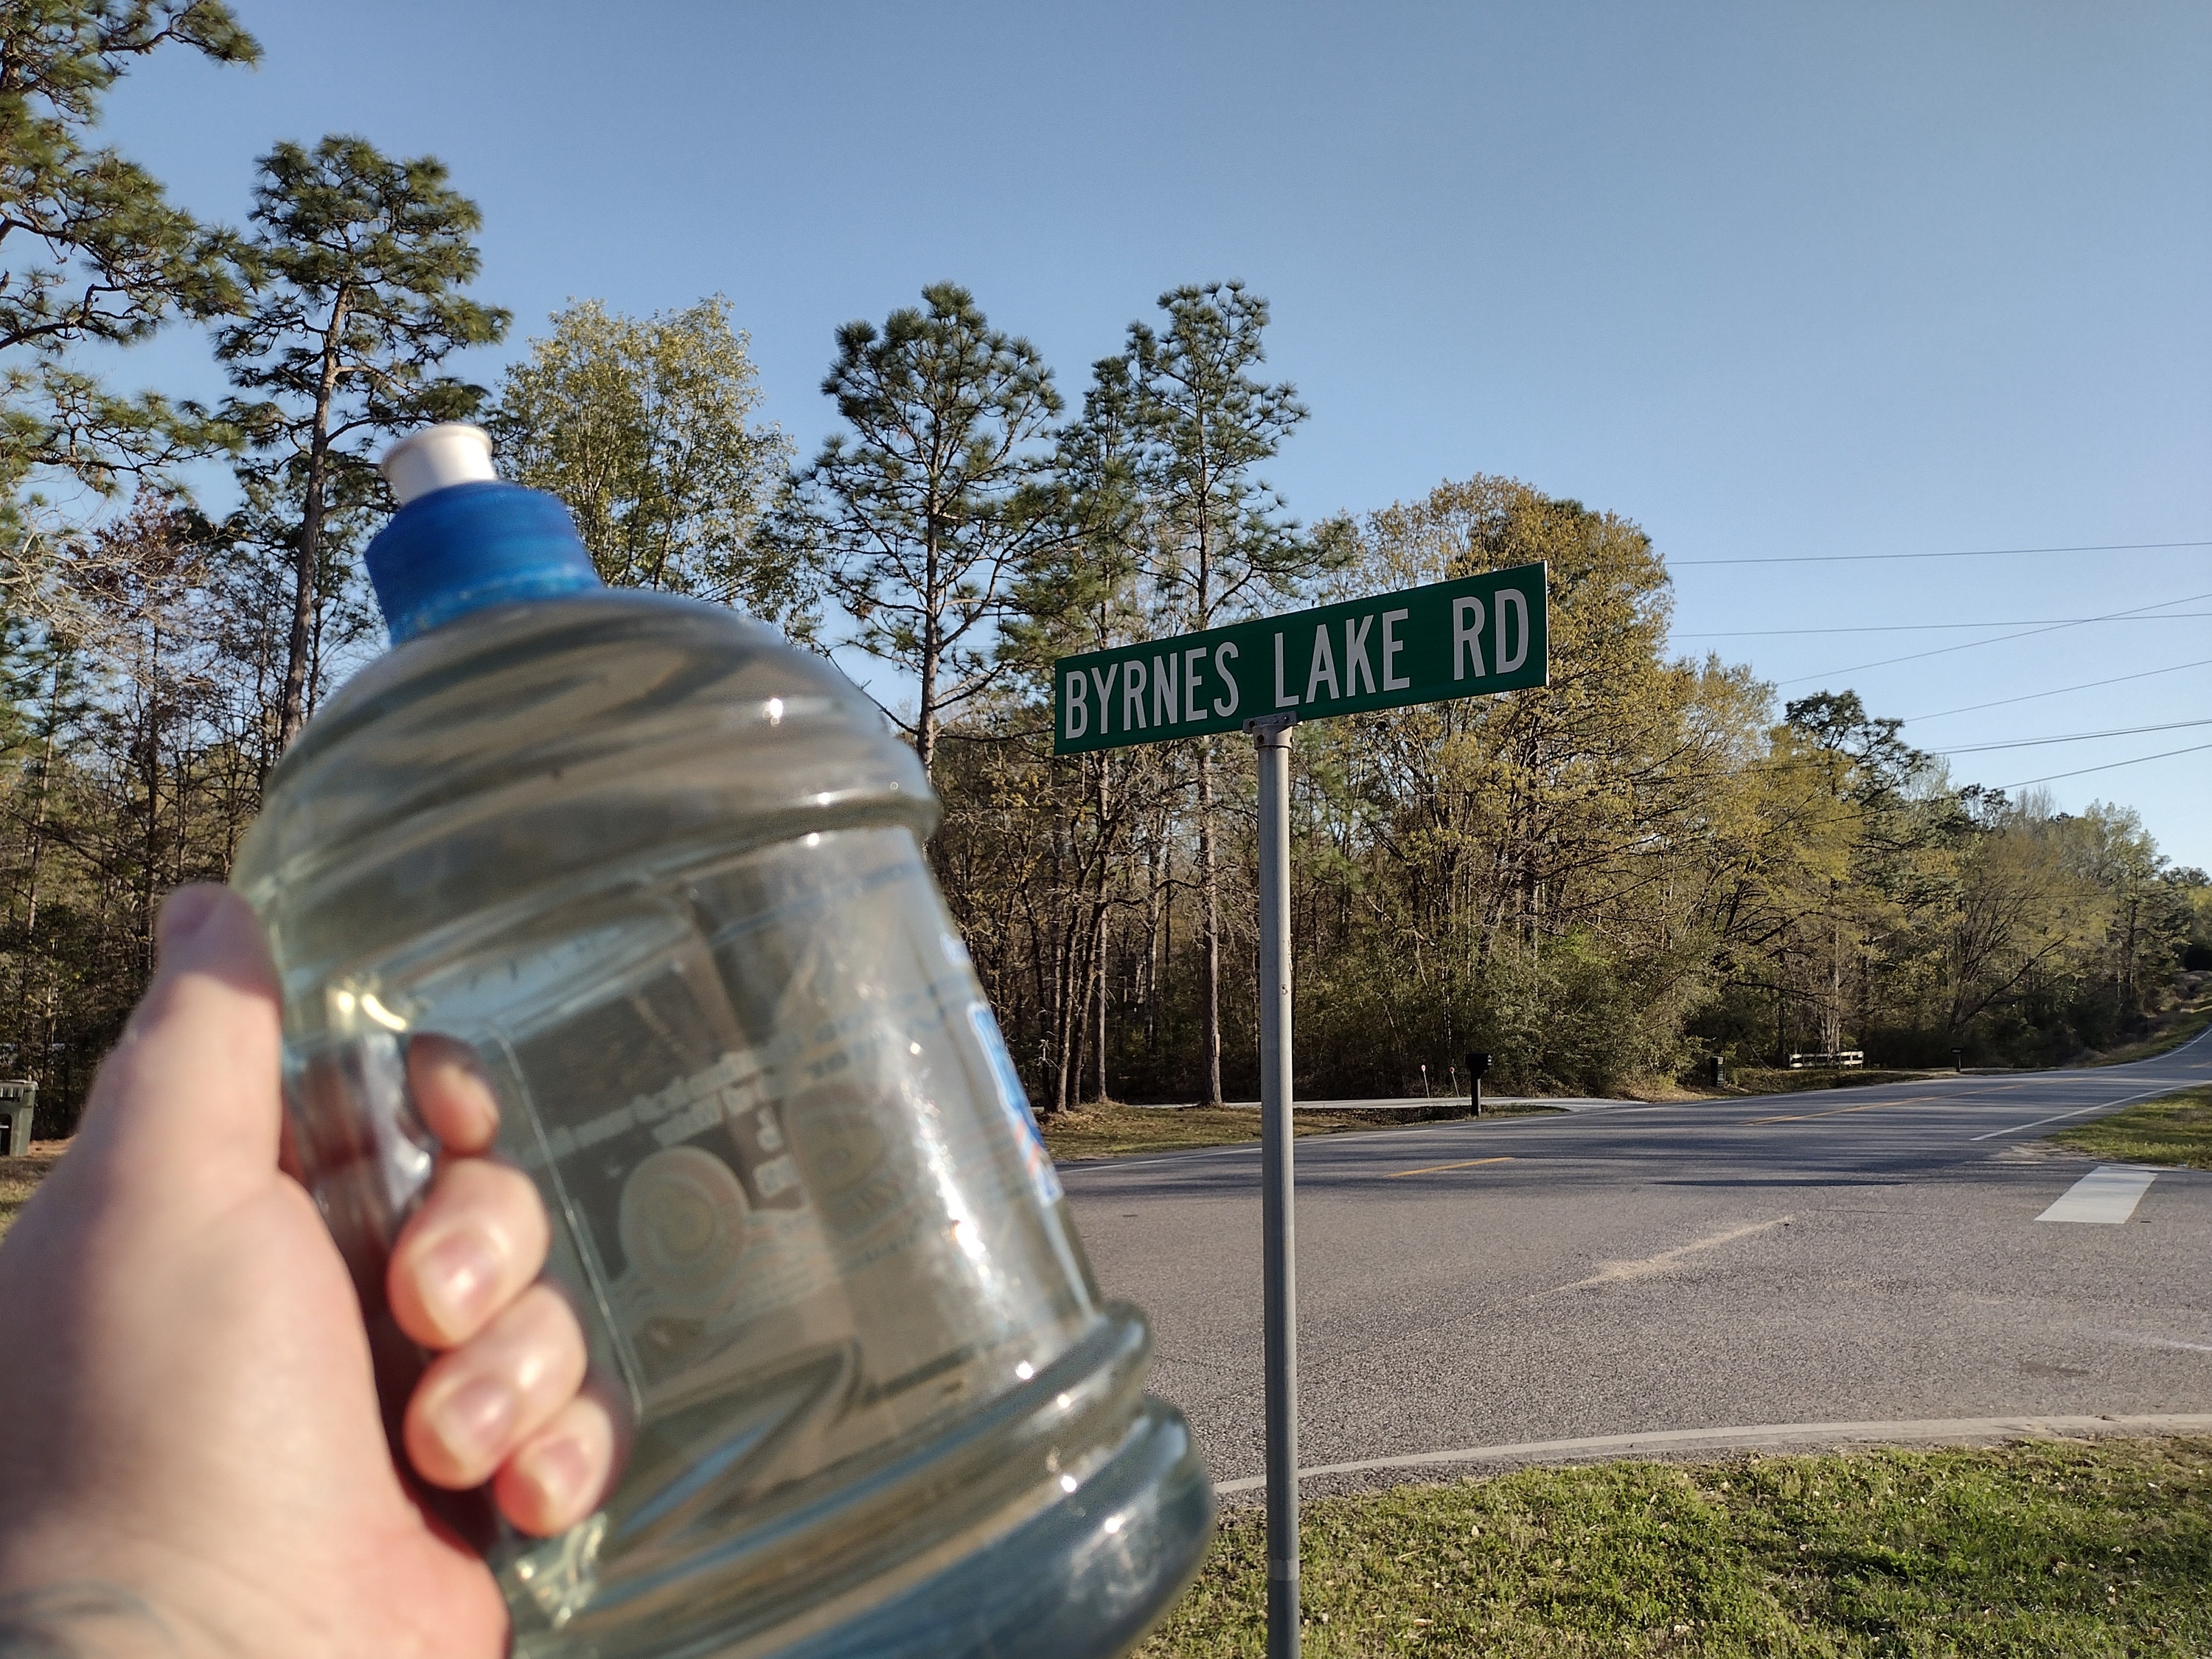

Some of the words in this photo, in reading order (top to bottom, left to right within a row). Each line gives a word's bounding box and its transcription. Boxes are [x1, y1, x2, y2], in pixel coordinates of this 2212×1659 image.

[1065, 642, 1239, 740] BYRNES
[1275, 608, 1411, 708] LAKE
[1453, 588, 1530, 681] RD
